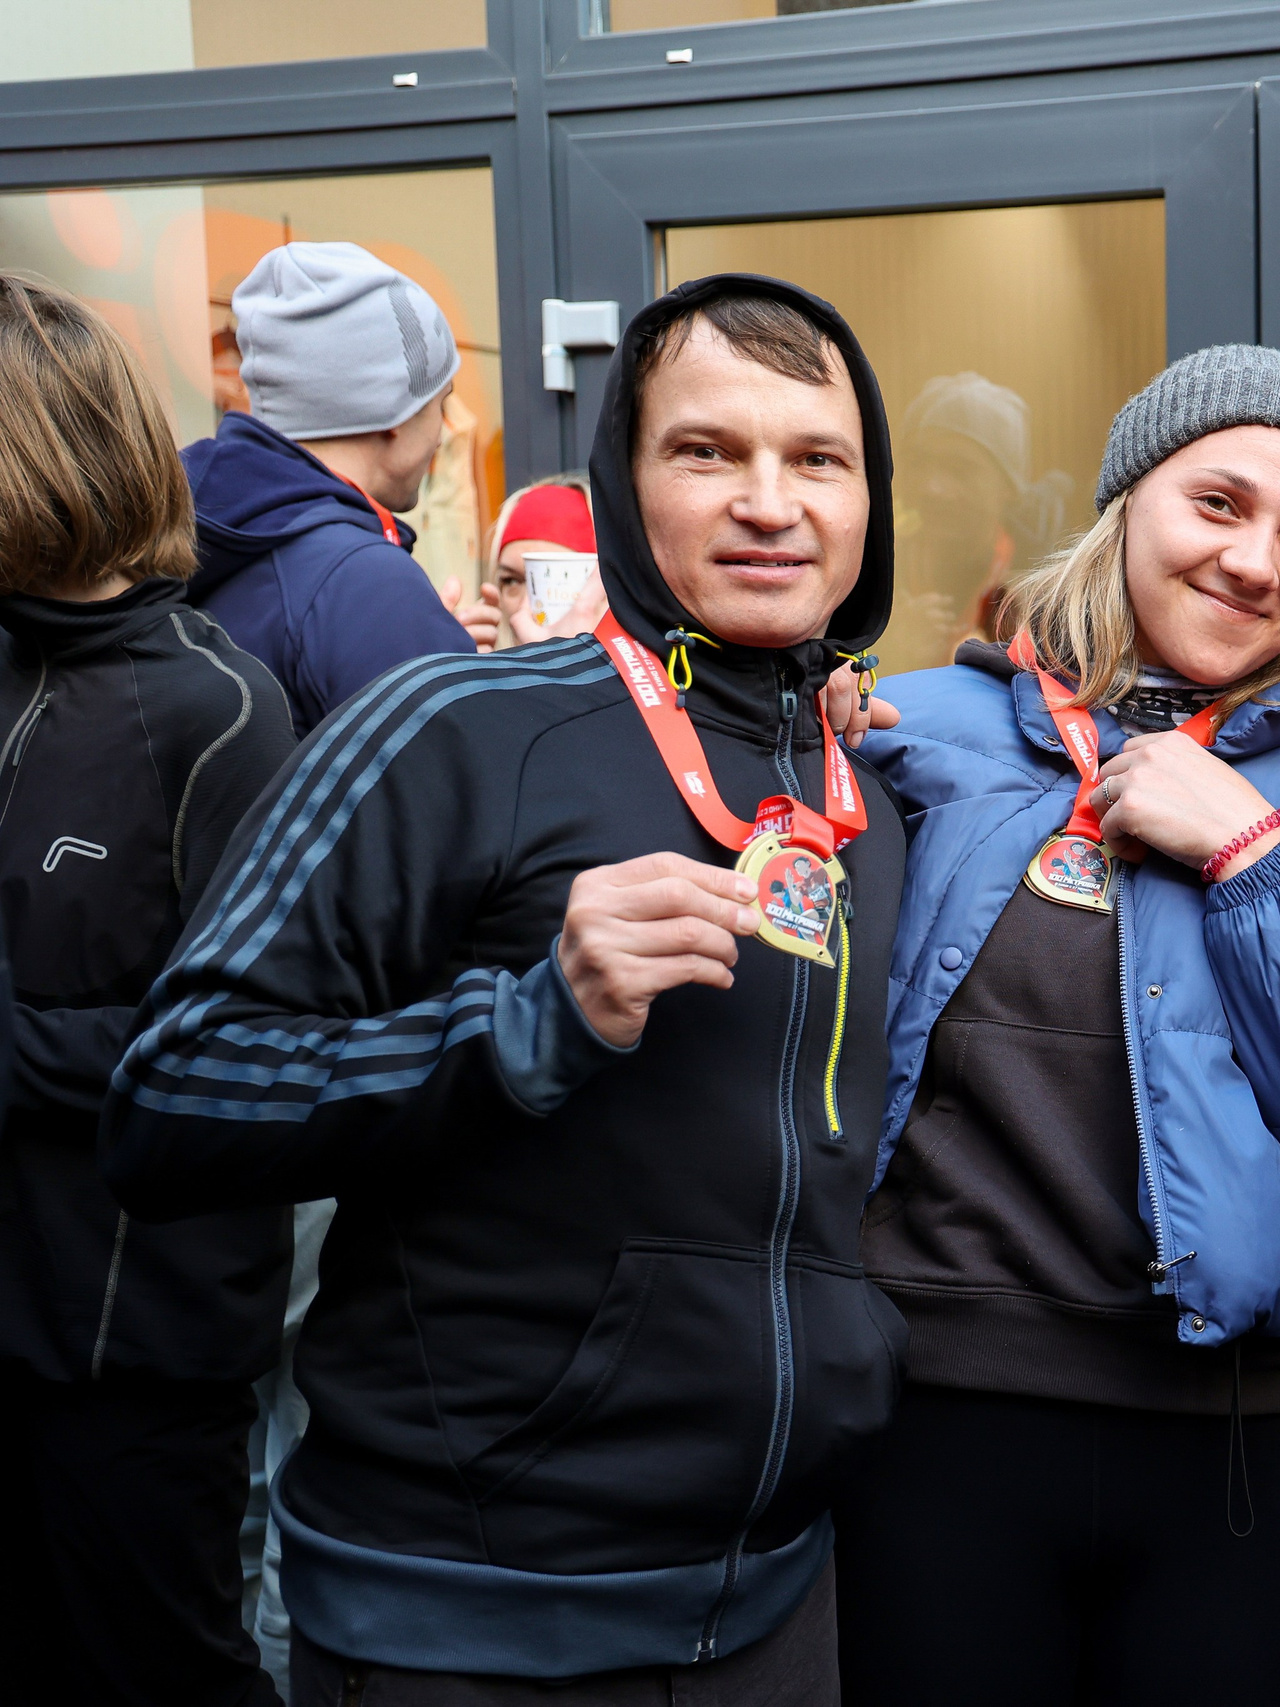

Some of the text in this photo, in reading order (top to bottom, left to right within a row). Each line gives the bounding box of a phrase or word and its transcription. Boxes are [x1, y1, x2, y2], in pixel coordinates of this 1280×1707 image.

[611, 636, 662, 707] 100 МЕТРОВКА
[1066, 722, 1092, 768] ТРОВКА
[1048, 873, 1064, 882] 100
[765, 903, 825, 932] 100 МЕТРОВКА
